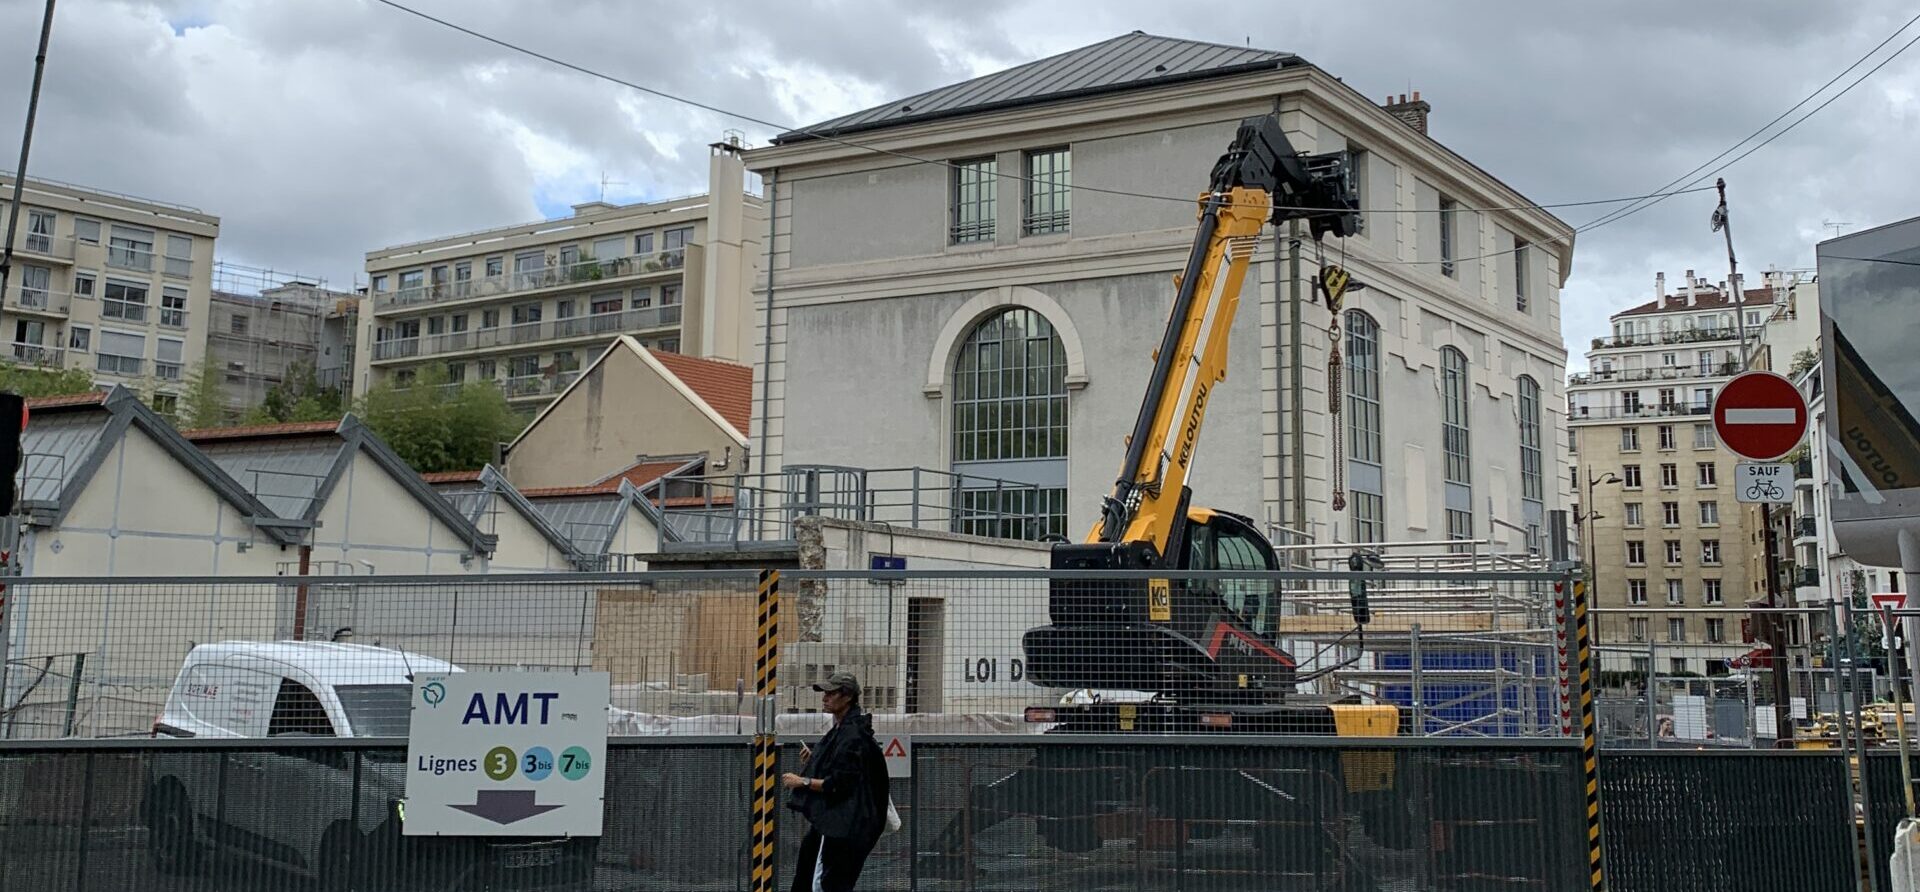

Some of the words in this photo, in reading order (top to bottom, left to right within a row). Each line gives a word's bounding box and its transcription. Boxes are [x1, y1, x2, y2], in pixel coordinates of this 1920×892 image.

[1748, 466, 1780, 476] SAUF
[964, 657, 996, 683] LOI
[461, 692, 559, 725] AMT
[418, 755, 477, 775] Lignes
[492, 753, 507, 774] 3
